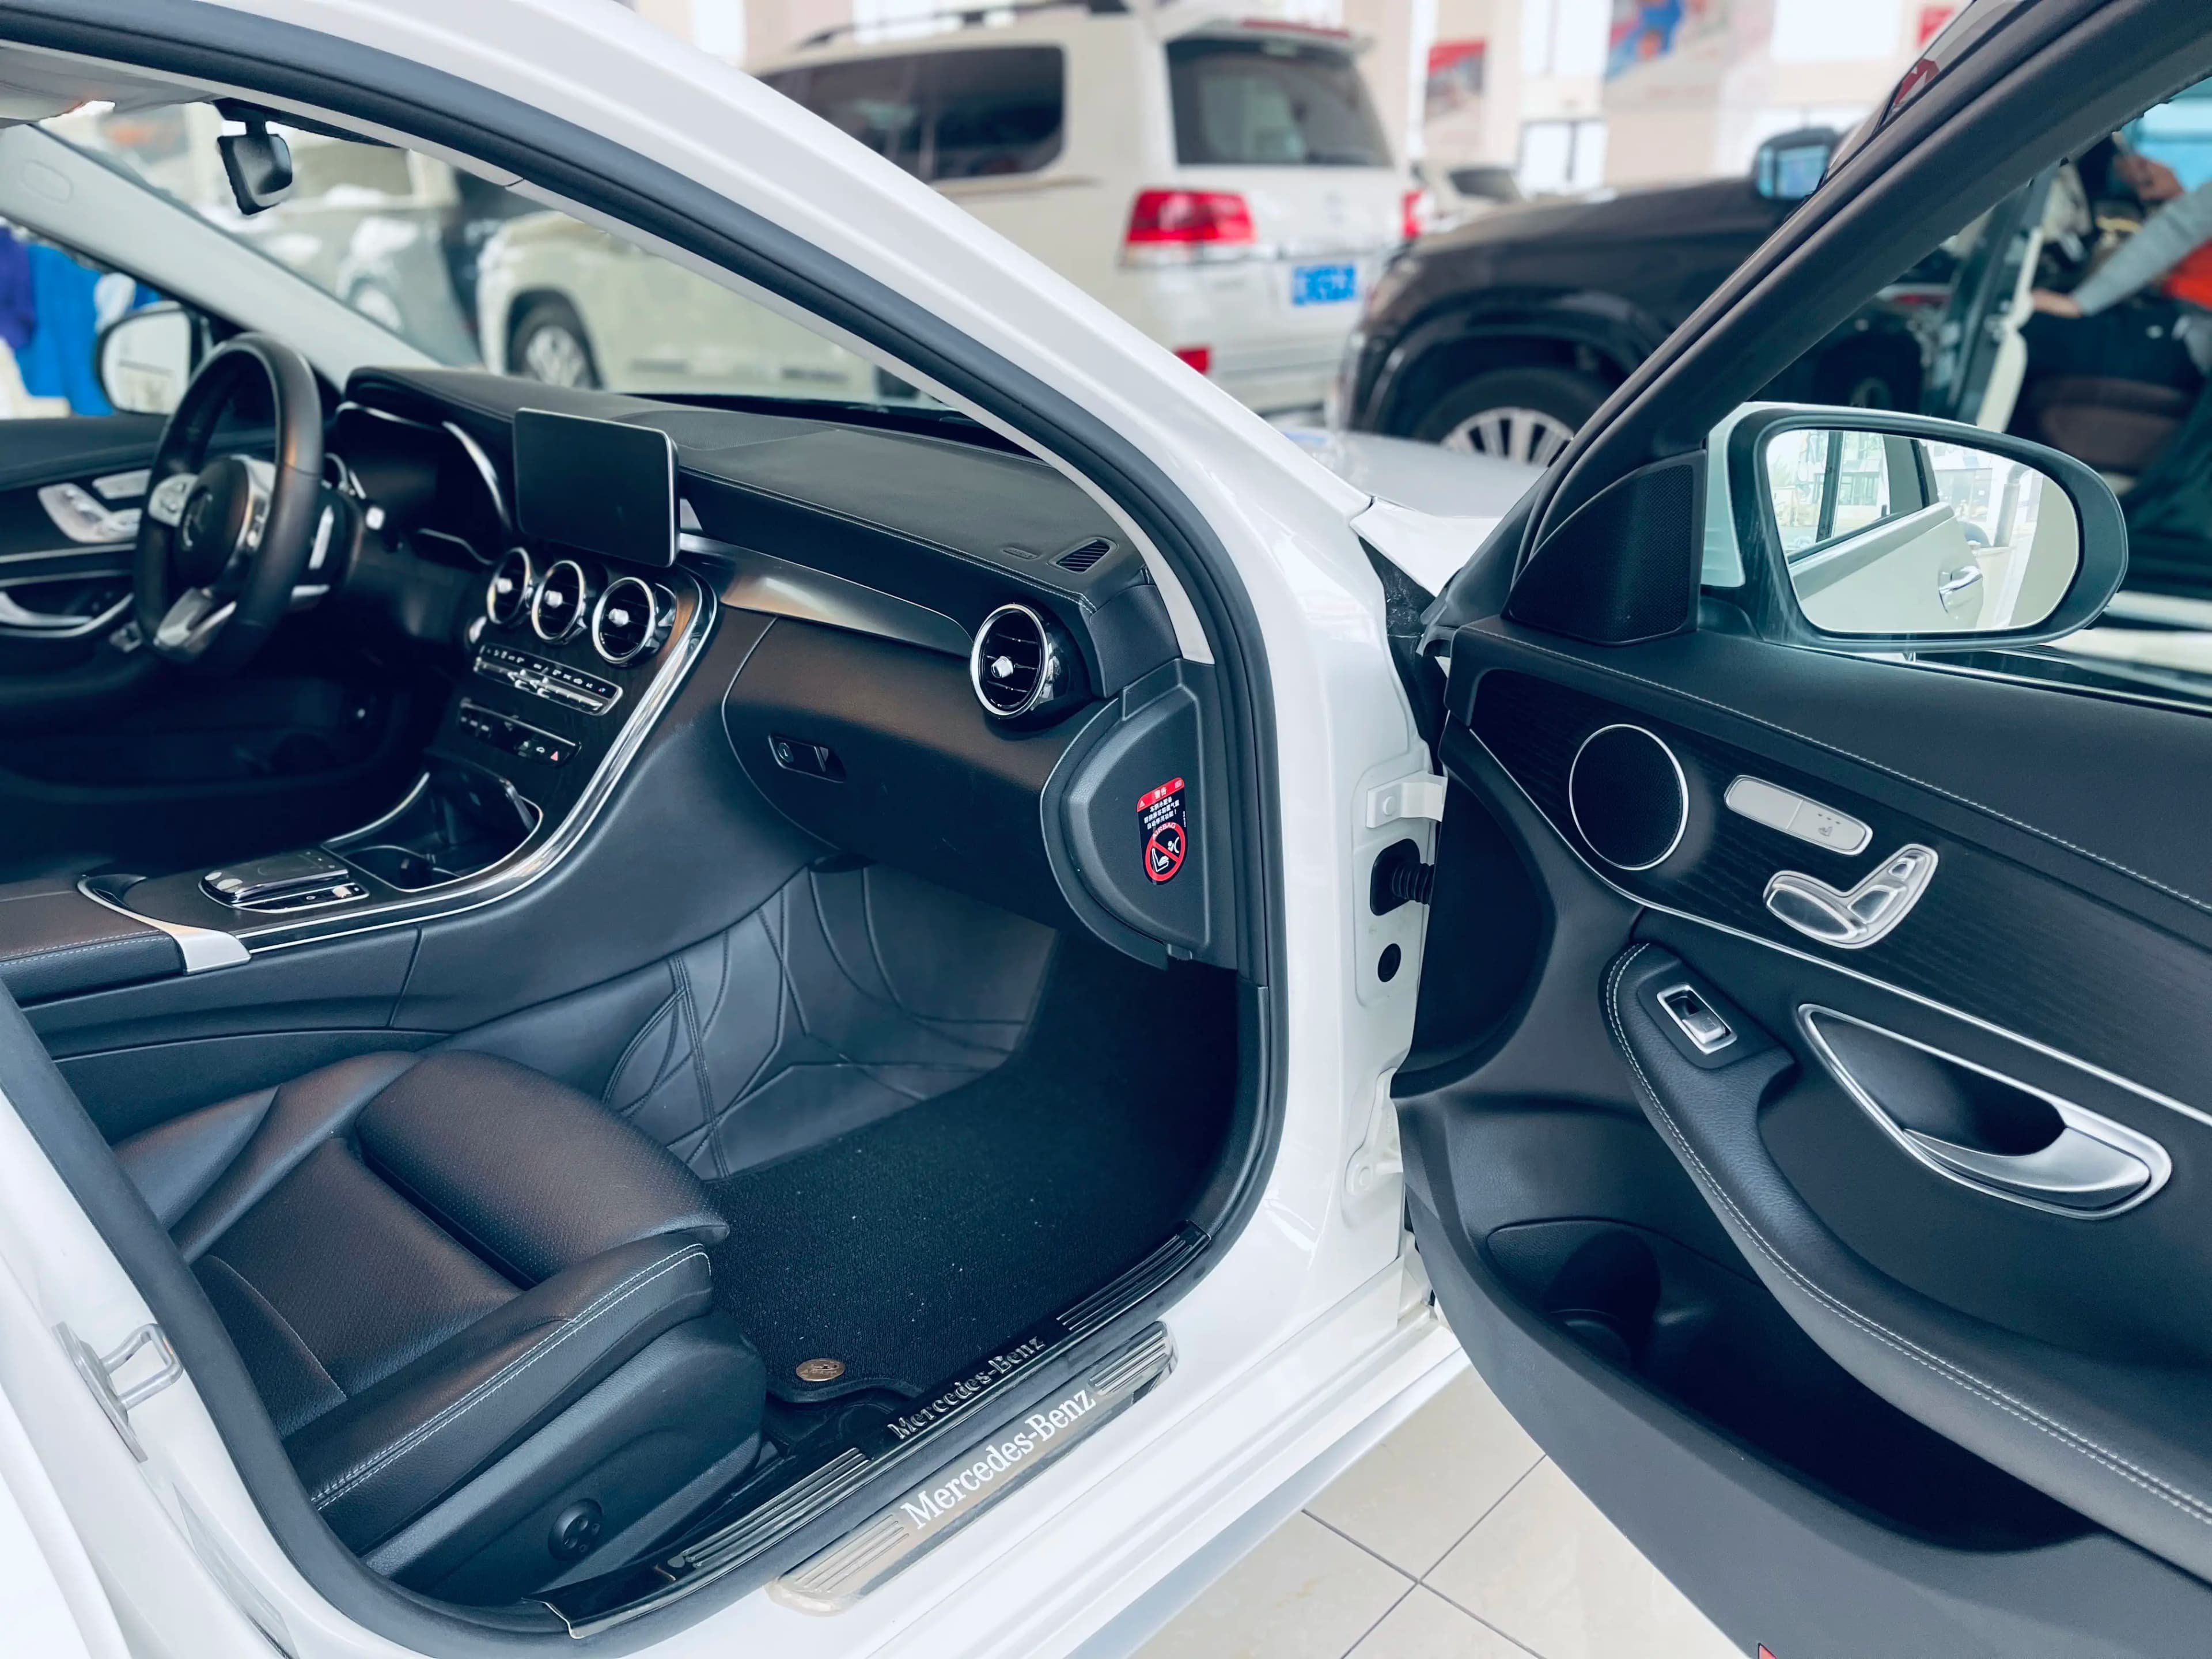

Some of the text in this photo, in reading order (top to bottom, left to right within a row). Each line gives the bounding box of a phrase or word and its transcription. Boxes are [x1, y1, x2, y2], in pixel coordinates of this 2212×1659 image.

[1153, 823, 1176, 840] AIRBAG
[888, 1336, 1046, 1440] Mercedes-Benz
[900, 1389, 1096, 1529] Mercedes-Benz
